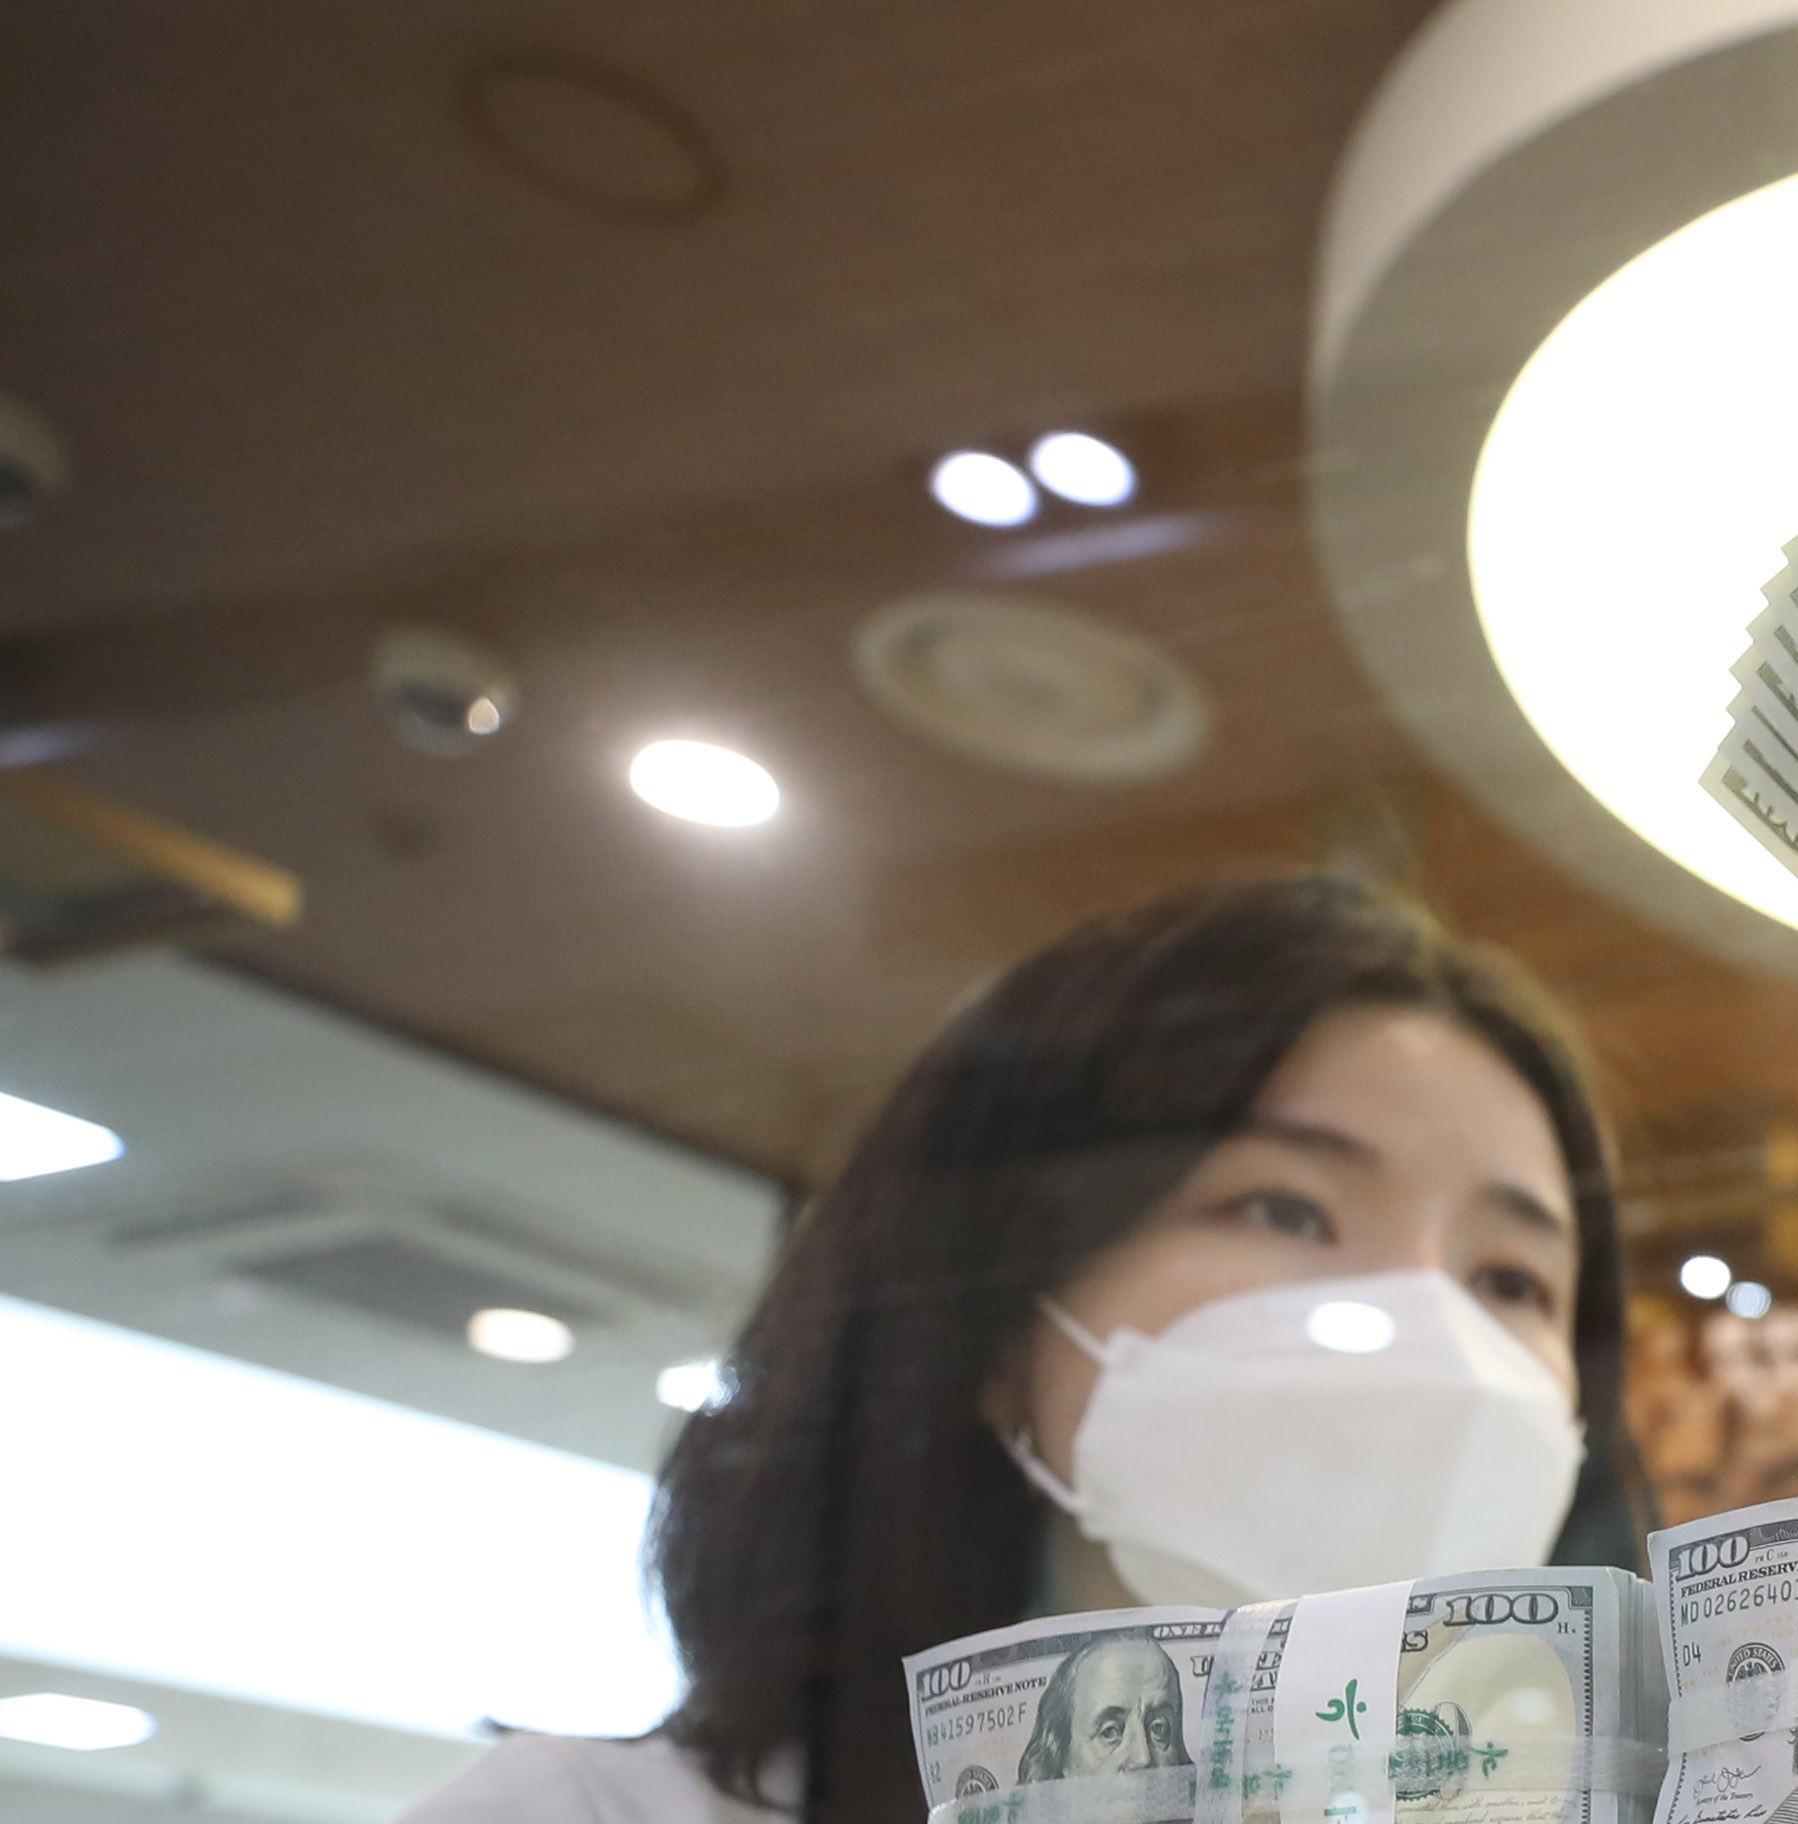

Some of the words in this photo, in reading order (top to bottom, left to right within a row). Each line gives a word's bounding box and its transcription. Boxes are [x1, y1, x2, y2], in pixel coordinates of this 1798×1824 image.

[1675, 1536, 1750, 1581] 100
[1680, 1574, 1736, 1598] FEDERAL
[1443, 1593, 1558, 1626] 100
[921, 1661, 973, 1700] 100
[1015, 1677, 1047, 1692] NOTE
[940, 1704, 1014, 1742] 41597502
